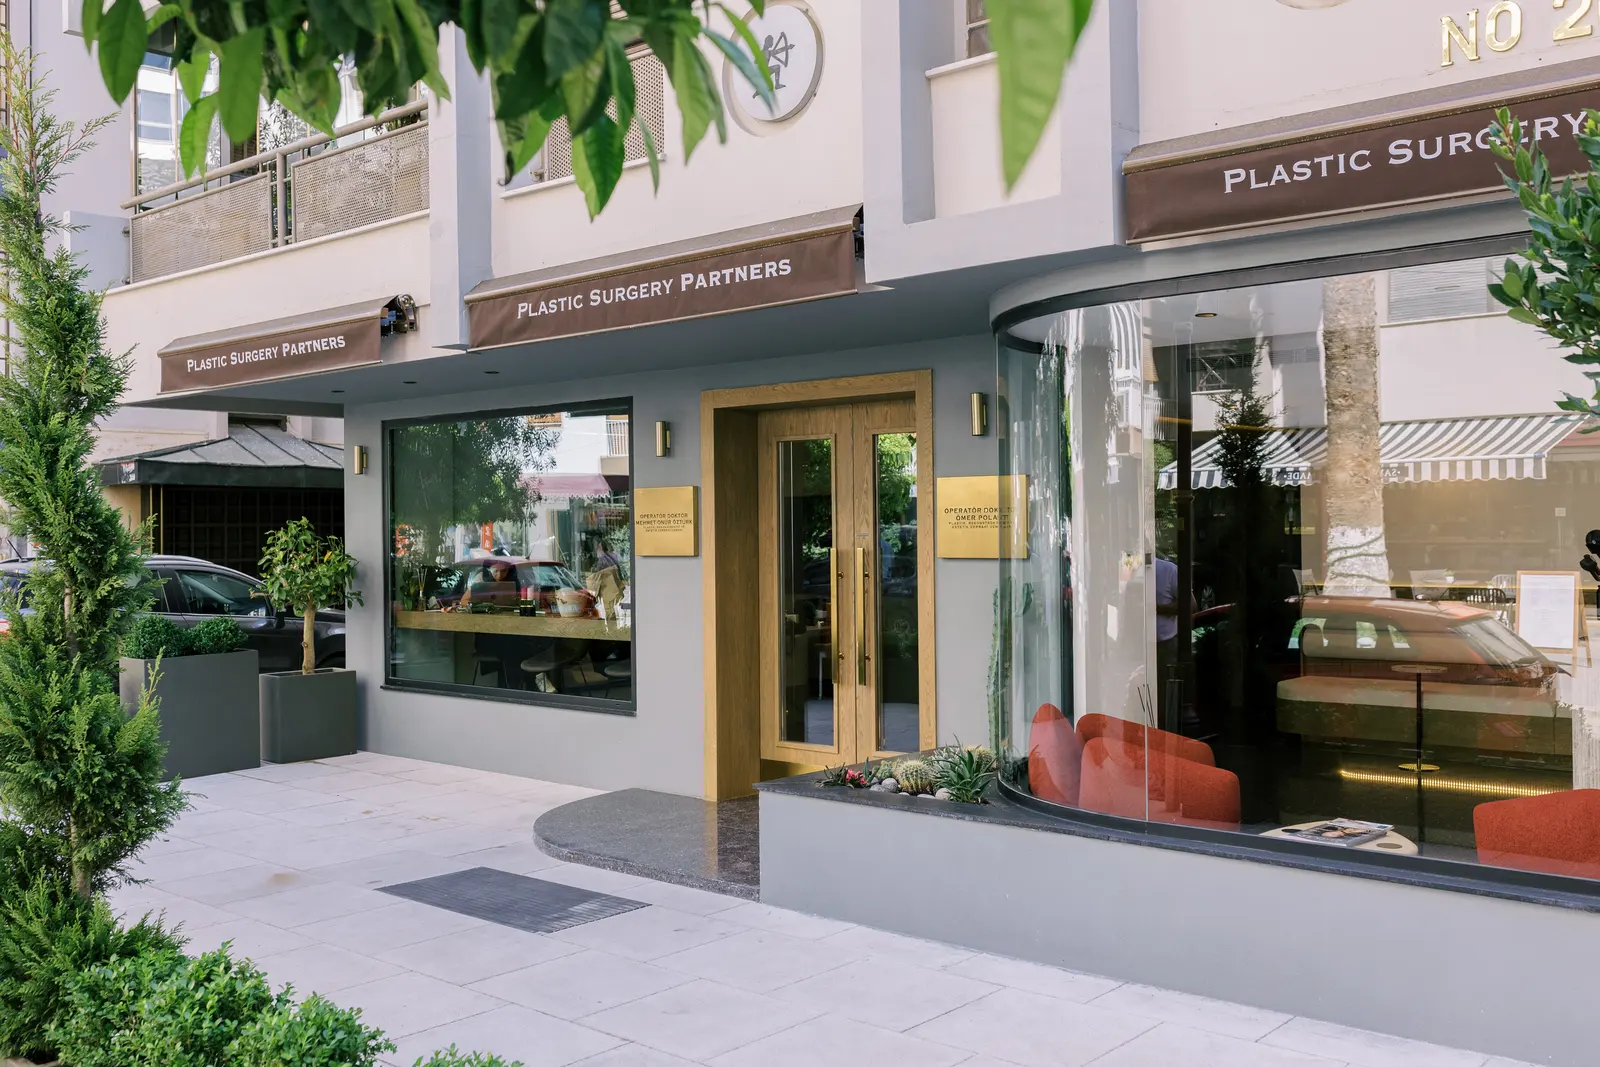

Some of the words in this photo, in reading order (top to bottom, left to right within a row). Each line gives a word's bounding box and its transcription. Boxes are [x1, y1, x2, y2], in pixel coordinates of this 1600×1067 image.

[1440, 0, 1522, 67] NO
[1553, 0, 1600, 41] 2
[1223, 149, 1372, 194] PLASTIC
[1388, 111, 1588, 165] SURGERY
[517, 296, 583, 319] PLASTIC
[589, 278, 674, 307] SURGERY
[680, 258, 792, 292] PARTNERS
[187, 355, 227, 372] PLASTIC
[230, 346, 279, 365] SURGERY
[282, 335, 346, 357] PARTNERS
